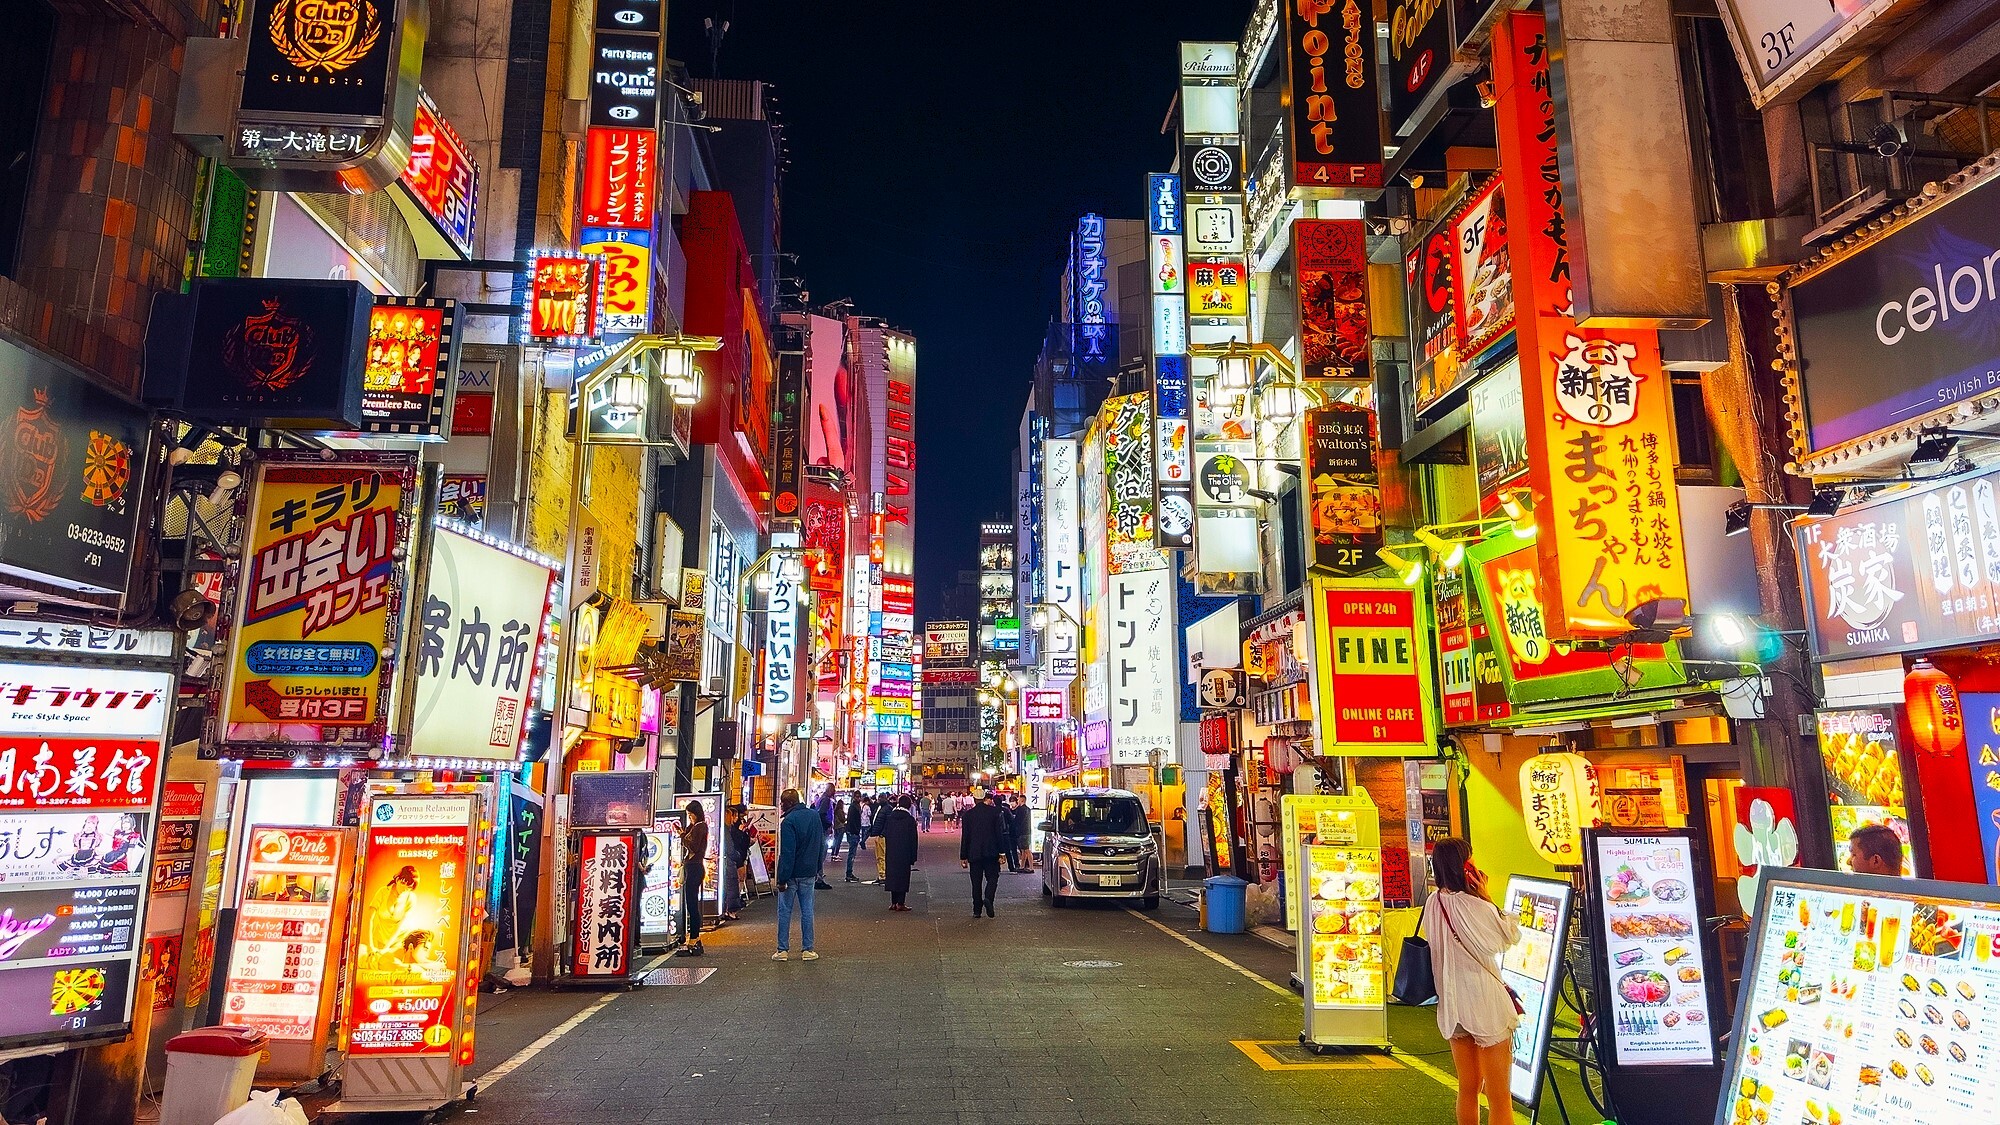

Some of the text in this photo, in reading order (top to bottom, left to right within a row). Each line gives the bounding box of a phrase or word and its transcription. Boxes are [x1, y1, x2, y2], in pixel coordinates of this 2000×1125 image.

[299, 2, 356, 21] Club
[621, 13, 636, 21] 4F
[306, 23, 343, 41] D12
[602, 48, 652, 60] Party Space
[1760, 21, 1797, 70] 3F
[1412, 54, 1427, 85] 4F
[616, 109, 631, 117] 3F
[242, 128, 369, 153] 第一大滝ビル
[607, 134, 629, 225] リフレッシュ
[444, 188, 467, 231] 3F
[633, 192, 645, 222] ホステル
[587, 214, 599, 223] 2F
[605, 231, 628, 241] 1F
[1462, 214, 1485, 254] 3F
[1195, 268, 1238, 287] 麻雀
[1081, 213, 1106, 362] カラオケの鉄人
[577, 344, 604, 369] Party
[1323, 367, 1354, 377] 3F
[1558, 363, 1632, 406] 新宿
[1937, 375, 1981, 402] Stylish
[1474, 388, 1489, 416] 2F
[610, 412, 626, 421] B1
[1588, 403, 1612, 422] の
[1318, 424, 1364, 435] BBQ 東京
[1317, 439, 1368, 450] Walton's
[1115, 405, 1140, 534] タン治郎
[1168, 467, 1180, 477] 1F
[1208, 477, 1242, 486] The Olive
[269, 473, 380, 534] キラリ
[1619, 434, 1651, 566] 九州のうまかもん
[1640, 432, 1673, 568] 博多もつ鍋 水炊き
[1564, 430, 1629, 618] まっちゃん
[67, 522, 126, 553] 03-6233-9552
[1804, 525, 1822, 545] 1F
[1926, 506, 1951, 578] 鍋料理
[1950, 490, 1975, 584] 七輪炙り
[1818, 522, 1900, 569] 大衆酒場
[91, 552, 102, 567] B1
[257, 513, 386, 610] 出会い
[1337, 549, 1363, 566] 2F
[1827, 550, 1905, 619] 炭家
[304, 575, 386, 633] カフェ
[1343, 603, 1397, 615] OPEN 24h
[1505, 601, 1544, 638] 新宿
[418, 594, 531, 692] 案内所
[1846, 627, 1890, 646] SUMIKA
[263, 646, 361, 661] 女性は全て無料!
[1118, 583, 1138, 726] トントン
[1338, 637, 1409, 664] FINE
[1526, 640, 1539, 658] の
[1445, 656, 1470, 686] FINE
[285, 686, 368, 697] いらっしゃいませ!
[1027, 693, 1061, 705] 24時間
[11, 712, 91, 723] Free Style Space
[279, 700, 365, 718] 受付3F
[1027, 706, 1061, 717] 営業中
[1342, 708, 1415, 720] ONLINE CAFE
[1372, 726, 1387, 738] B1
[1531, 770, 1557, 784] 新宿
[164, 790, 203, 803] Flamingo
[397, 803, 466, 812] Aroma Relaxation
[1532, 793, 1558, 855] まっちゃん
[292, 835, 327, 854] Pink
[374, 834, 464, 847] Welcom to relaxing
[289, 852, 330, 863] Flamingo
[397, 848, 439, 859] massage
[1606, 849, 1635, 858] Highball
[173, 861, 191, 872] 3F
[579, 858, 598, 951] ファイナルアンサー
[595, 843, 627, 969] 無料案内所
[1774, 890, 1796, 908] 炭家
[434, 861, 457, 965] 癒しスペース
[240, 920, 283, 931] ナイトパック
[47, 947, 71, 957] LADY
[248, 944, 261, 953] 60
[246, 956, 259, 965] 90
[239, 967, 257, 977] 120
[232, 996, 244, 1010] 5F
[397, 998, 439, 1012] ¥5,000
[73, 1017, 87, 1028] B1
[361, 1029, 424, 1041] 03-6457-3885
